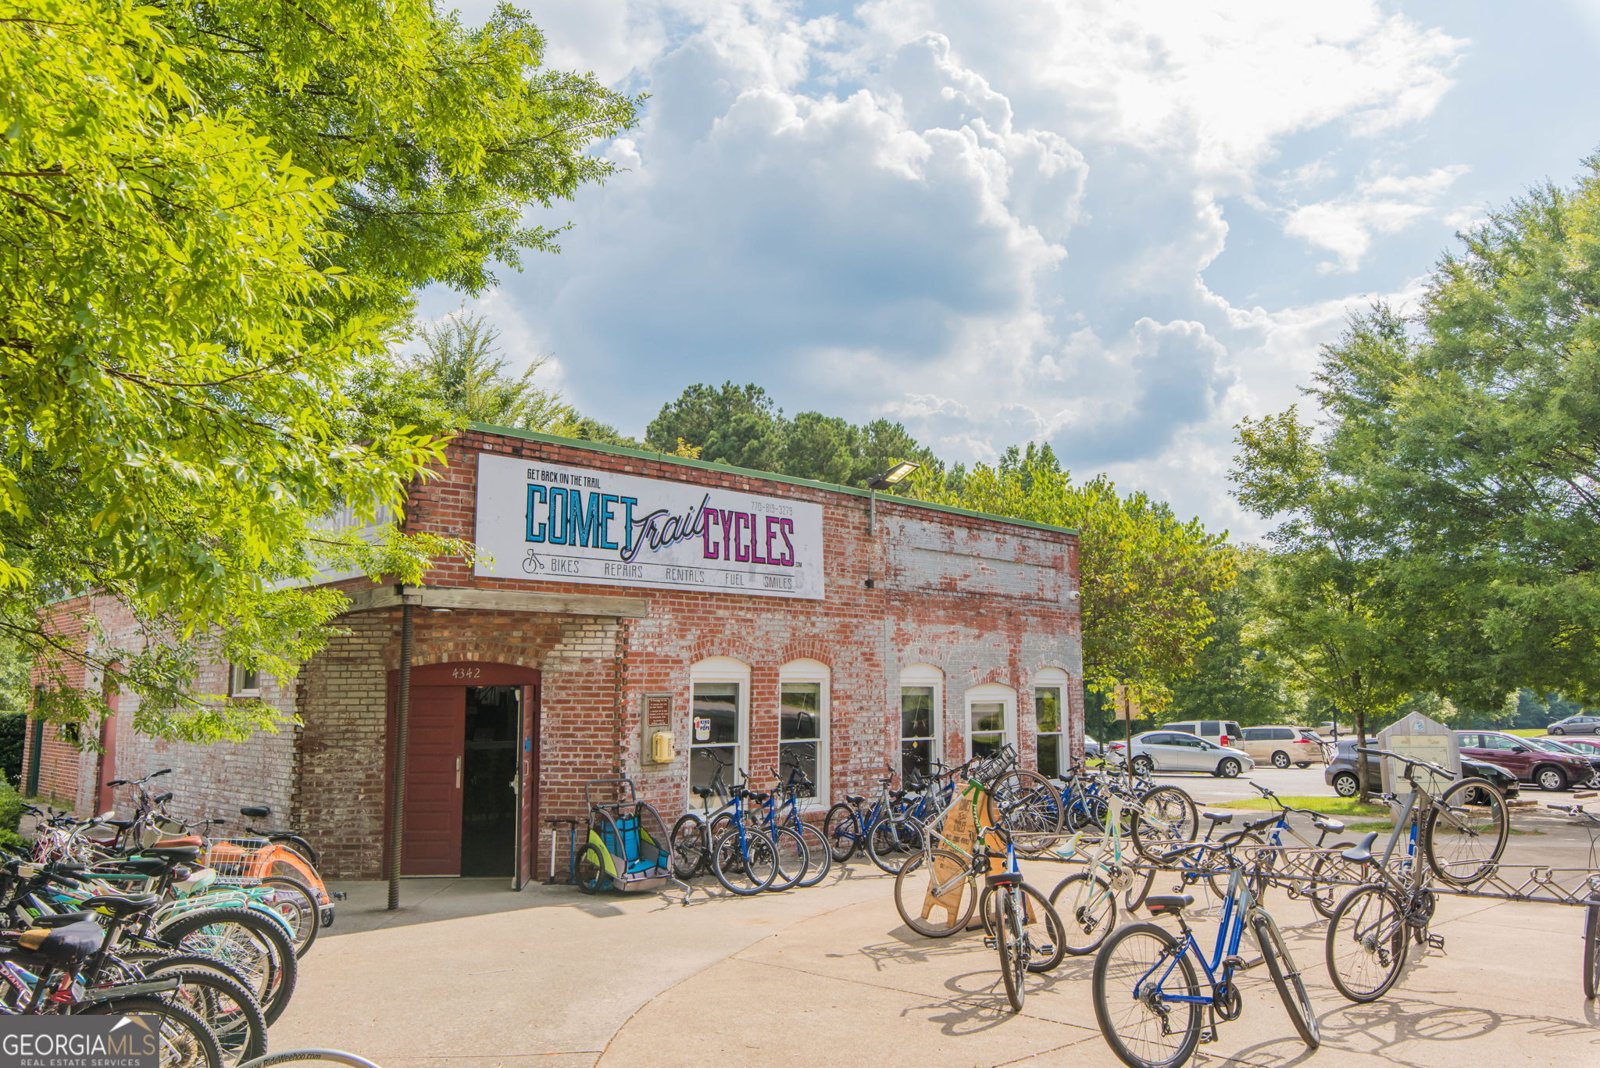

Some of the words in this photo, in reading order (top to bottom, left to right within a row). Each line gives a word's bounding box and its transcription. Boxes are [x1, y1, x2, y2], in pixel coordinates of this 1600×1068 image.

[527, 468, 540, 480] GET
[541, 470, 558, 482] BACK
[559, 472, 569, 485] ON
[570, 474, 583, 487] THE
[583, 475, 601, 489] TRAIL
[525, 483, 638, 550] COMET
[620, 493, 711, 564] Trail
[703, 507, 795, 567] CYCLES
[551, 558, 580, 574] BIKES
[604, 563, 643, 578] REPAIRS
[665, 567, 705, 583] RENTALS
[725, 572, 745, 586] FUEL
[763, 576, 793, 590] SMILES
[452, 667, 481, 679] 4342
